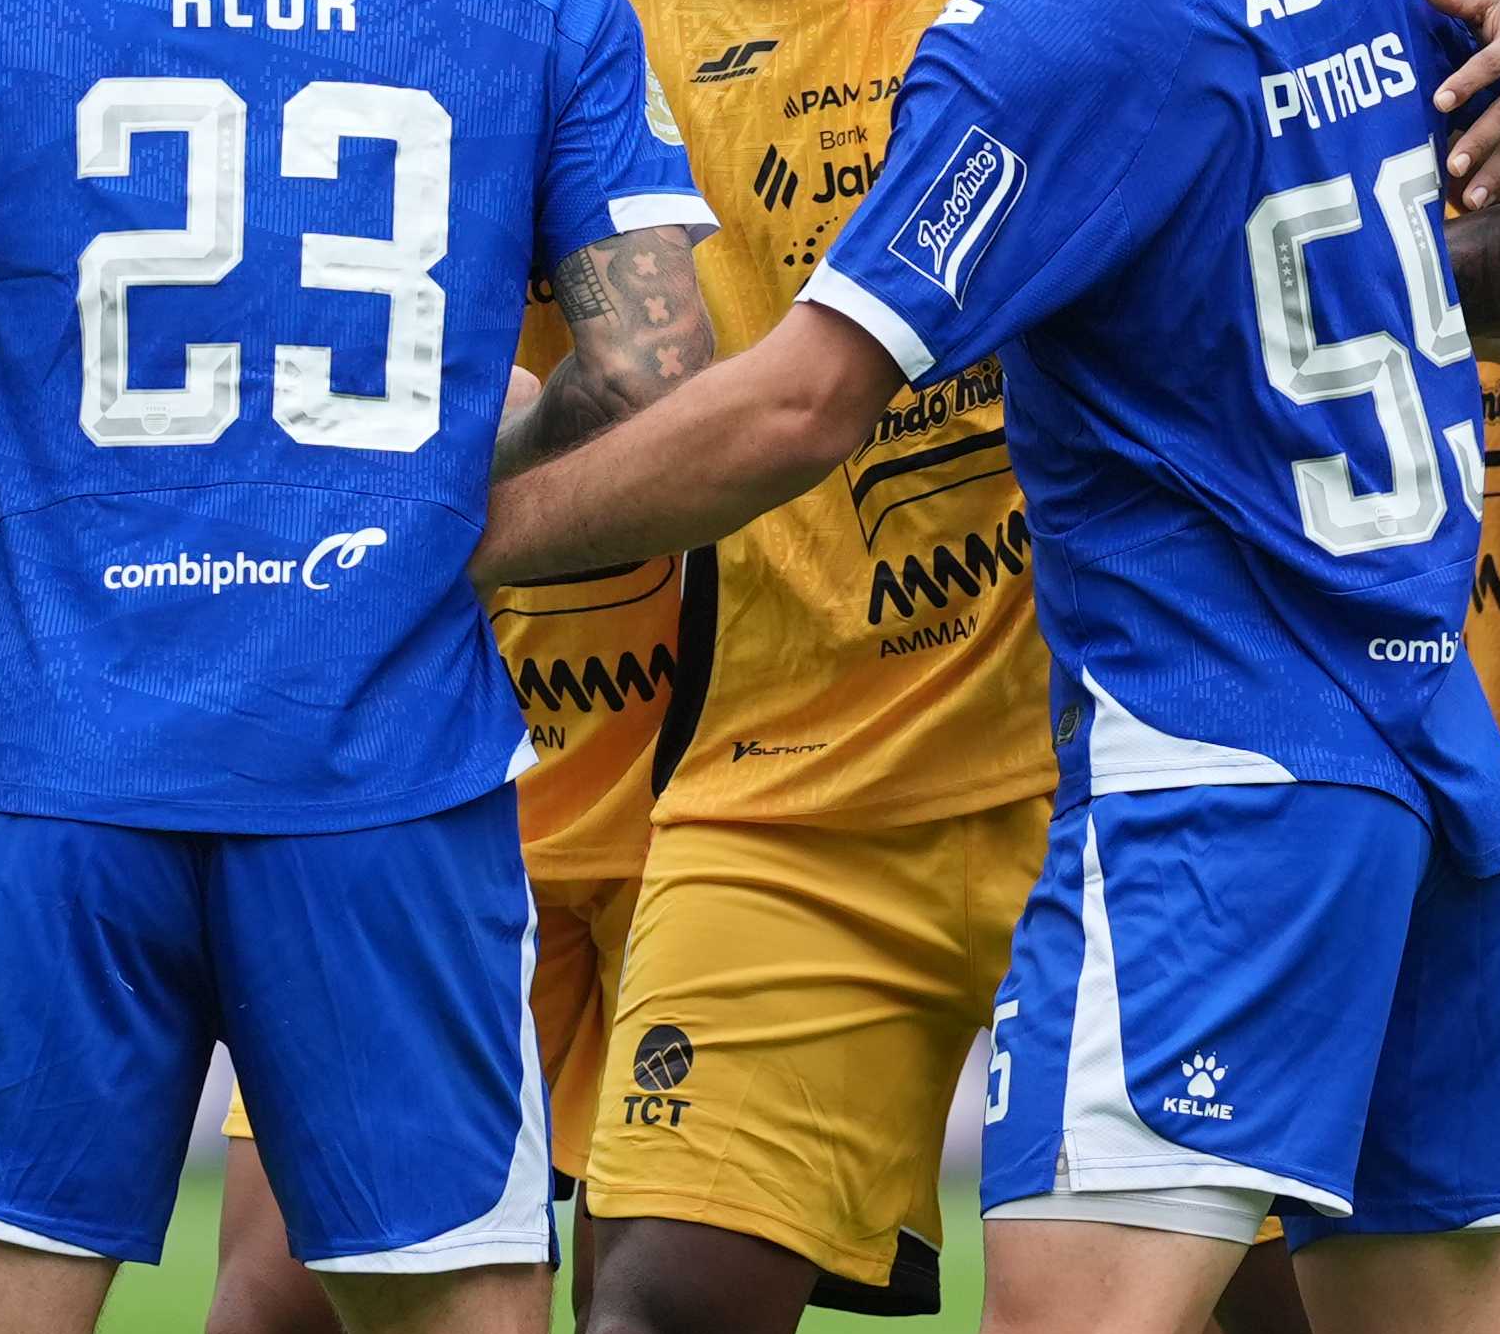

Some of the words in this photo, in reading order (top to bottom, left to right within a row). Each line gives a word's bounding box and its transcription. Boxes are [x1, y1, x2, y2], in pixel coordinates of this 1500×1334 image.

[868, 76, 903, 101] JA
[820, 125, 869, 150] Bank
[812, 153, 887, 204] Jak
[918, 150, 997, 274] Indomie
[76, 77, 452, 454] 23
[103, 553, 298, 596] combiphar
[623, 1095, 691, 1128] TCT
[1163, 1095, 1234, 1121] KELME
